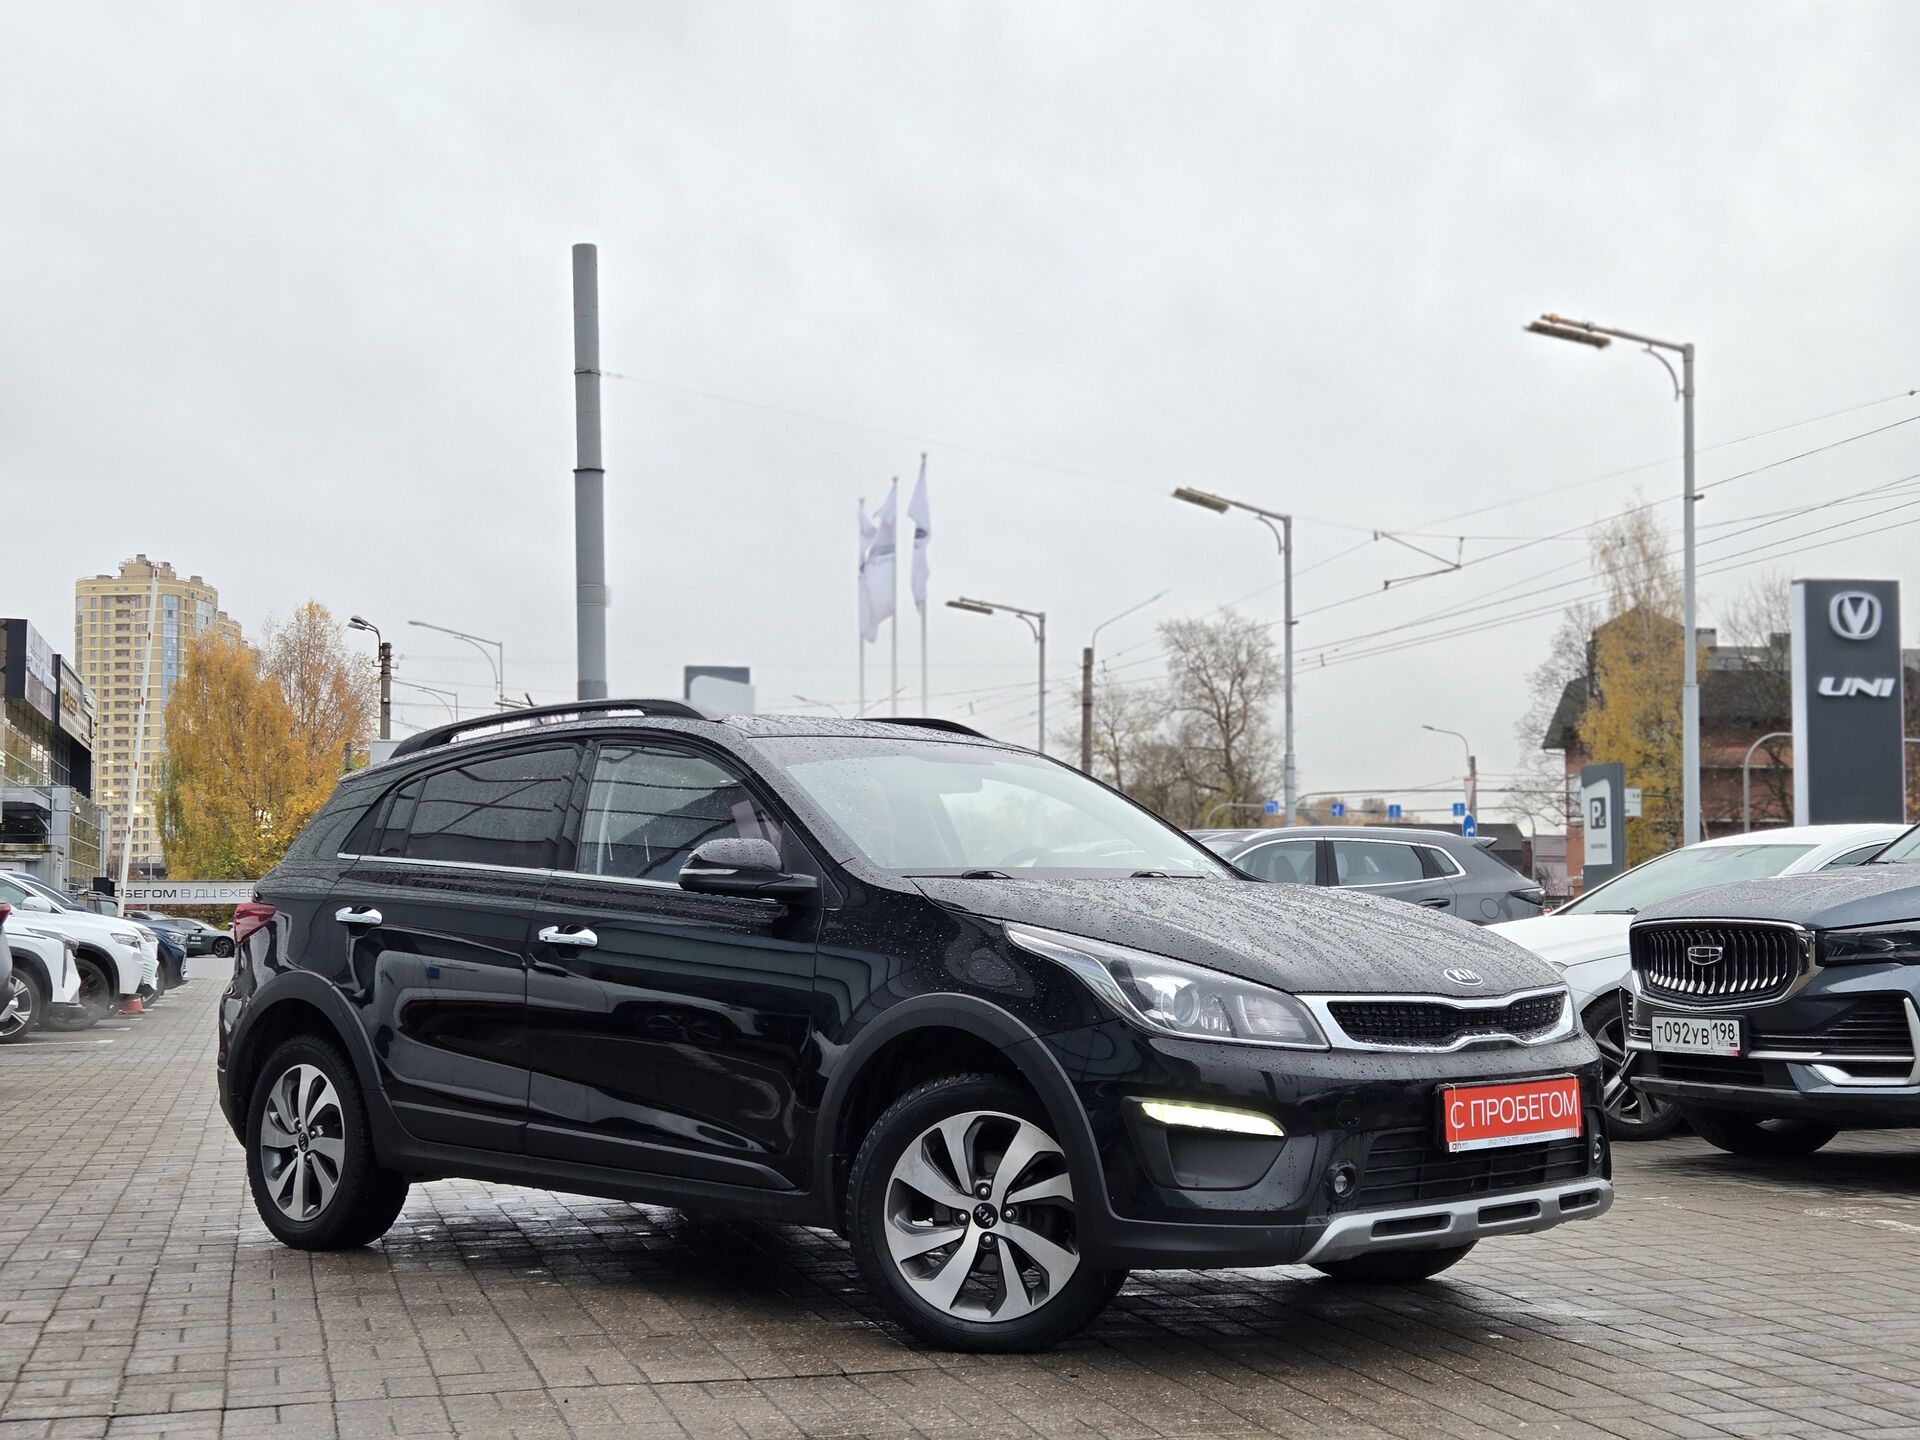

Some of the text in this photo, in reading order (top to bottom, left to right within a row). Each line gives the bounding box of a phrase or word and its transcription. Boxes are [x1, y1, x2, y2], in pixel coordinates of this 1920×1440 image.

[1818, 677, 1895, 697] UNI
[181, 889, 191, 898] В
[194, 889, 216, 899] ДЦ
[1712, 1022, 1735, 1040] 198
[1450, 1090, 1578, 1129] С ПРОБЕГОМ
[975, 1205, 994, 1227] KIA
